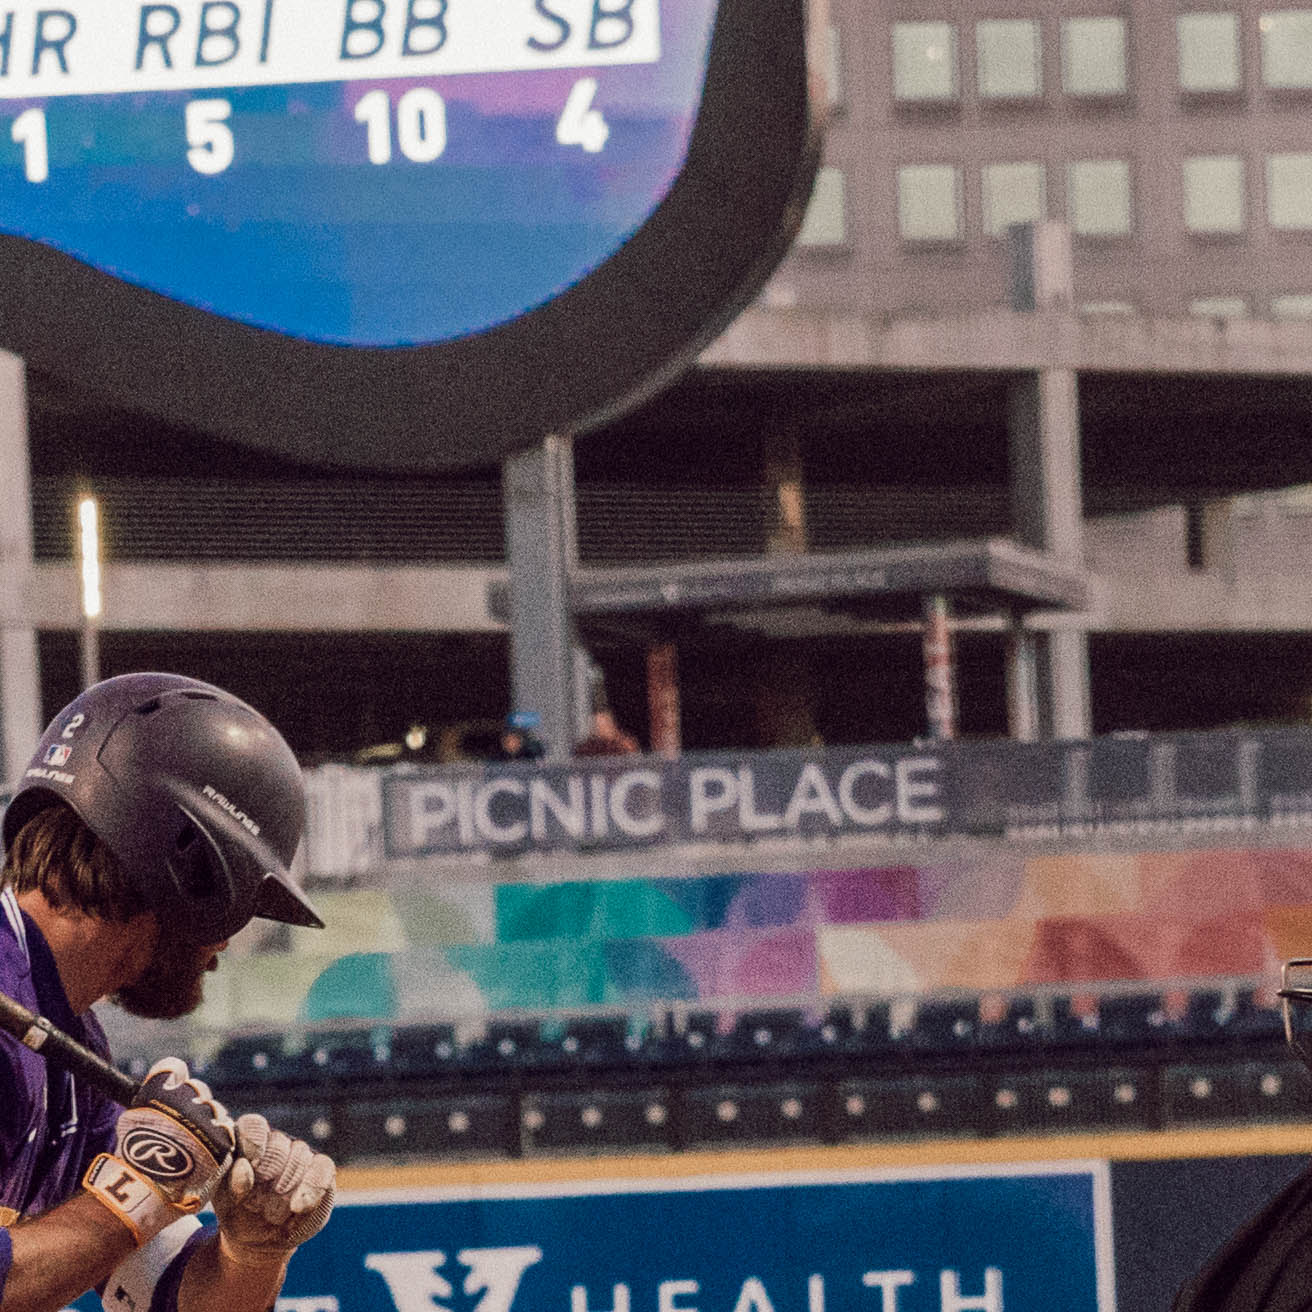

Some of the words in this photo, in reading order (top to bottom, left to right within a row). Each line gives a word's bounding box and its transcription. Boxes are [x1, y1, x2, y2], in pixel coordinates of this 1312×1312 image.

[134, 0, 271, 70] RBI
[340, 0, 448, 61] BB
[528, 0, 634, 52] SB
[11, 108, 48, 184] 1
[185, 99, 235, 175] 5
[354, 88, 446, 165] 10
[555, 78, 609, 153] 4
[62, 713, 85, 738] 2
[410, 772, 665, 846] PICNIC
[690, 758, 946, 831] PLACE
[106, 1173, 134, 1204] L
